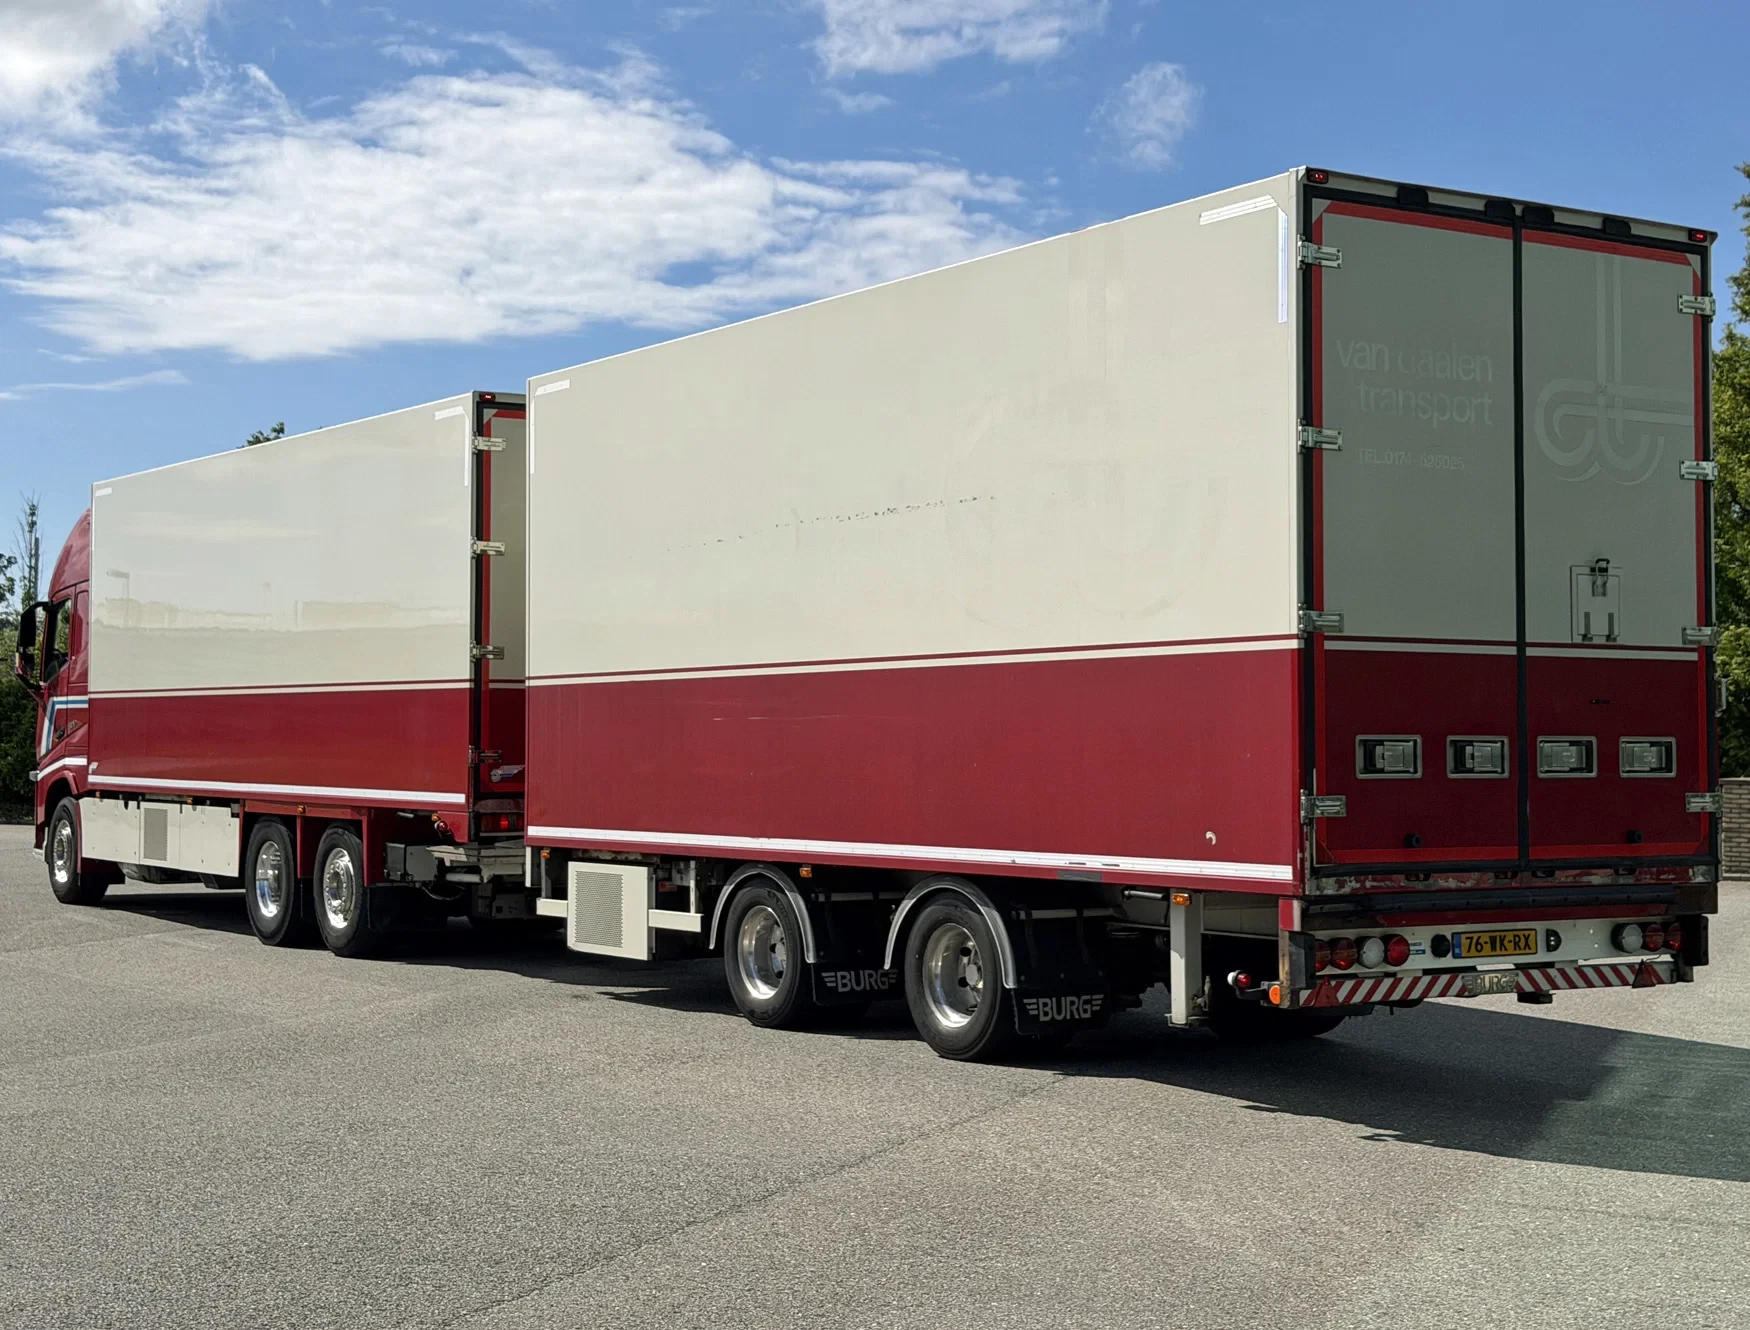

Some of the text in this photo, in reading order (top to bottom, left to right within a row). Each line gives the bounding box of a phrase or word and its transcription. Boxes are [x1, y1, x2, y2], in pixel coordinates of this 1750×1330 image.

[1336, 339, 1391, 372] van
[1353, 379, 1493, 429] transport
[1464, 933, 1533, 954] 76-WK-RX
[836, 969, 890, 993] BURG
[1476, 972, 1510, 993] BURG
[1038, 995, 1092, 1022] BURG
